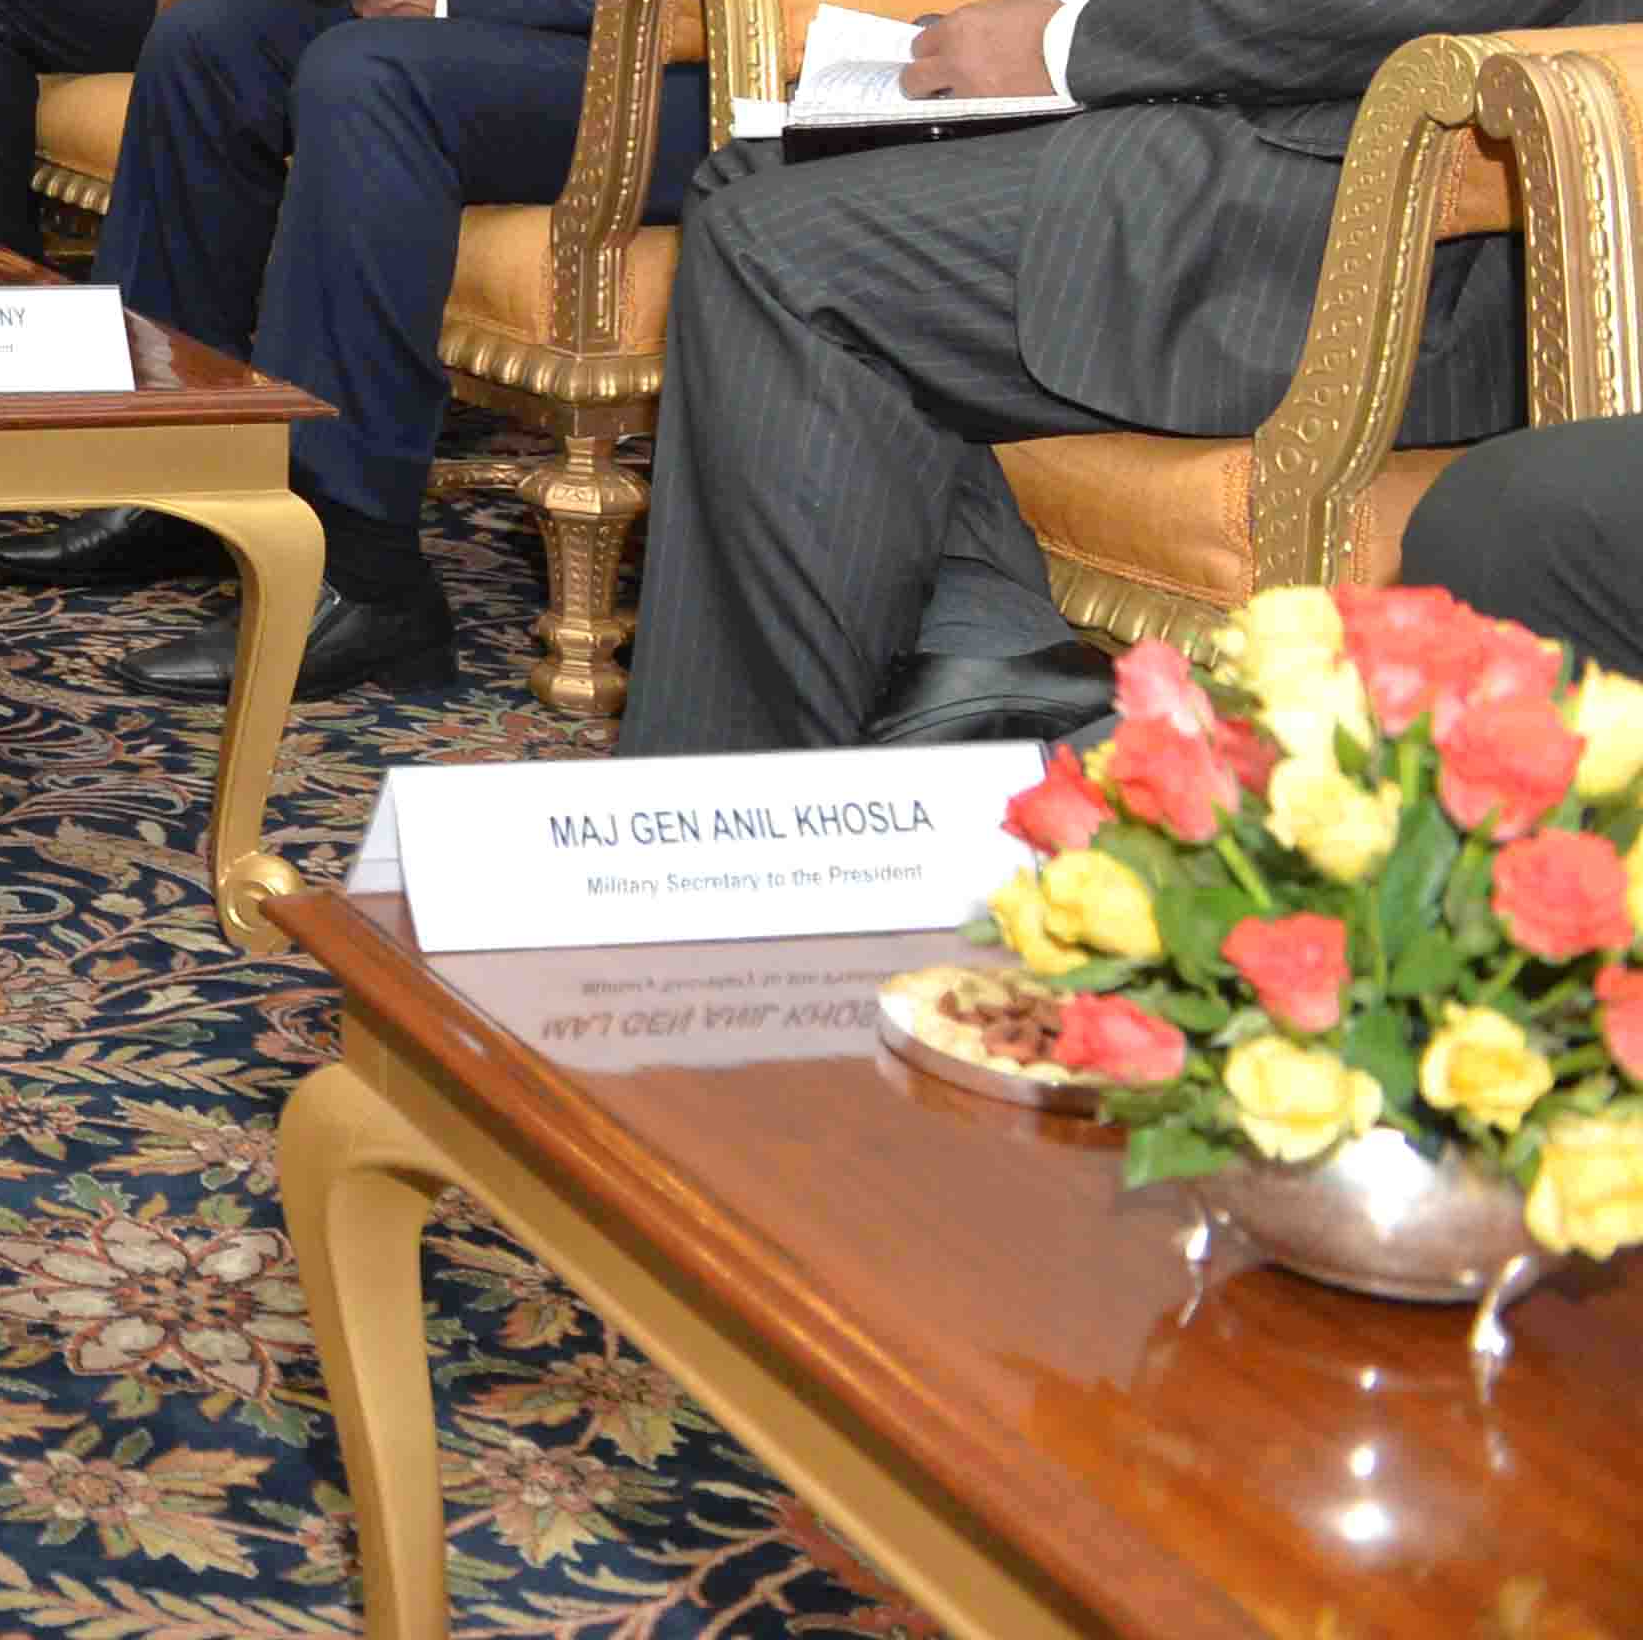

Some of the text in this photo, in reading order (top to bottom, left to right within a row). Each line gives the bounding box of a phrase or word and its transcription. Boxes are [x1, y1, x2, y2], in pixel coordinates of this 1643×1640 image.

[549, 800, 936, 849] MAJ GEN ANIL KHOSLA
[587, 862, 923, 903] Military Secretary to the President
